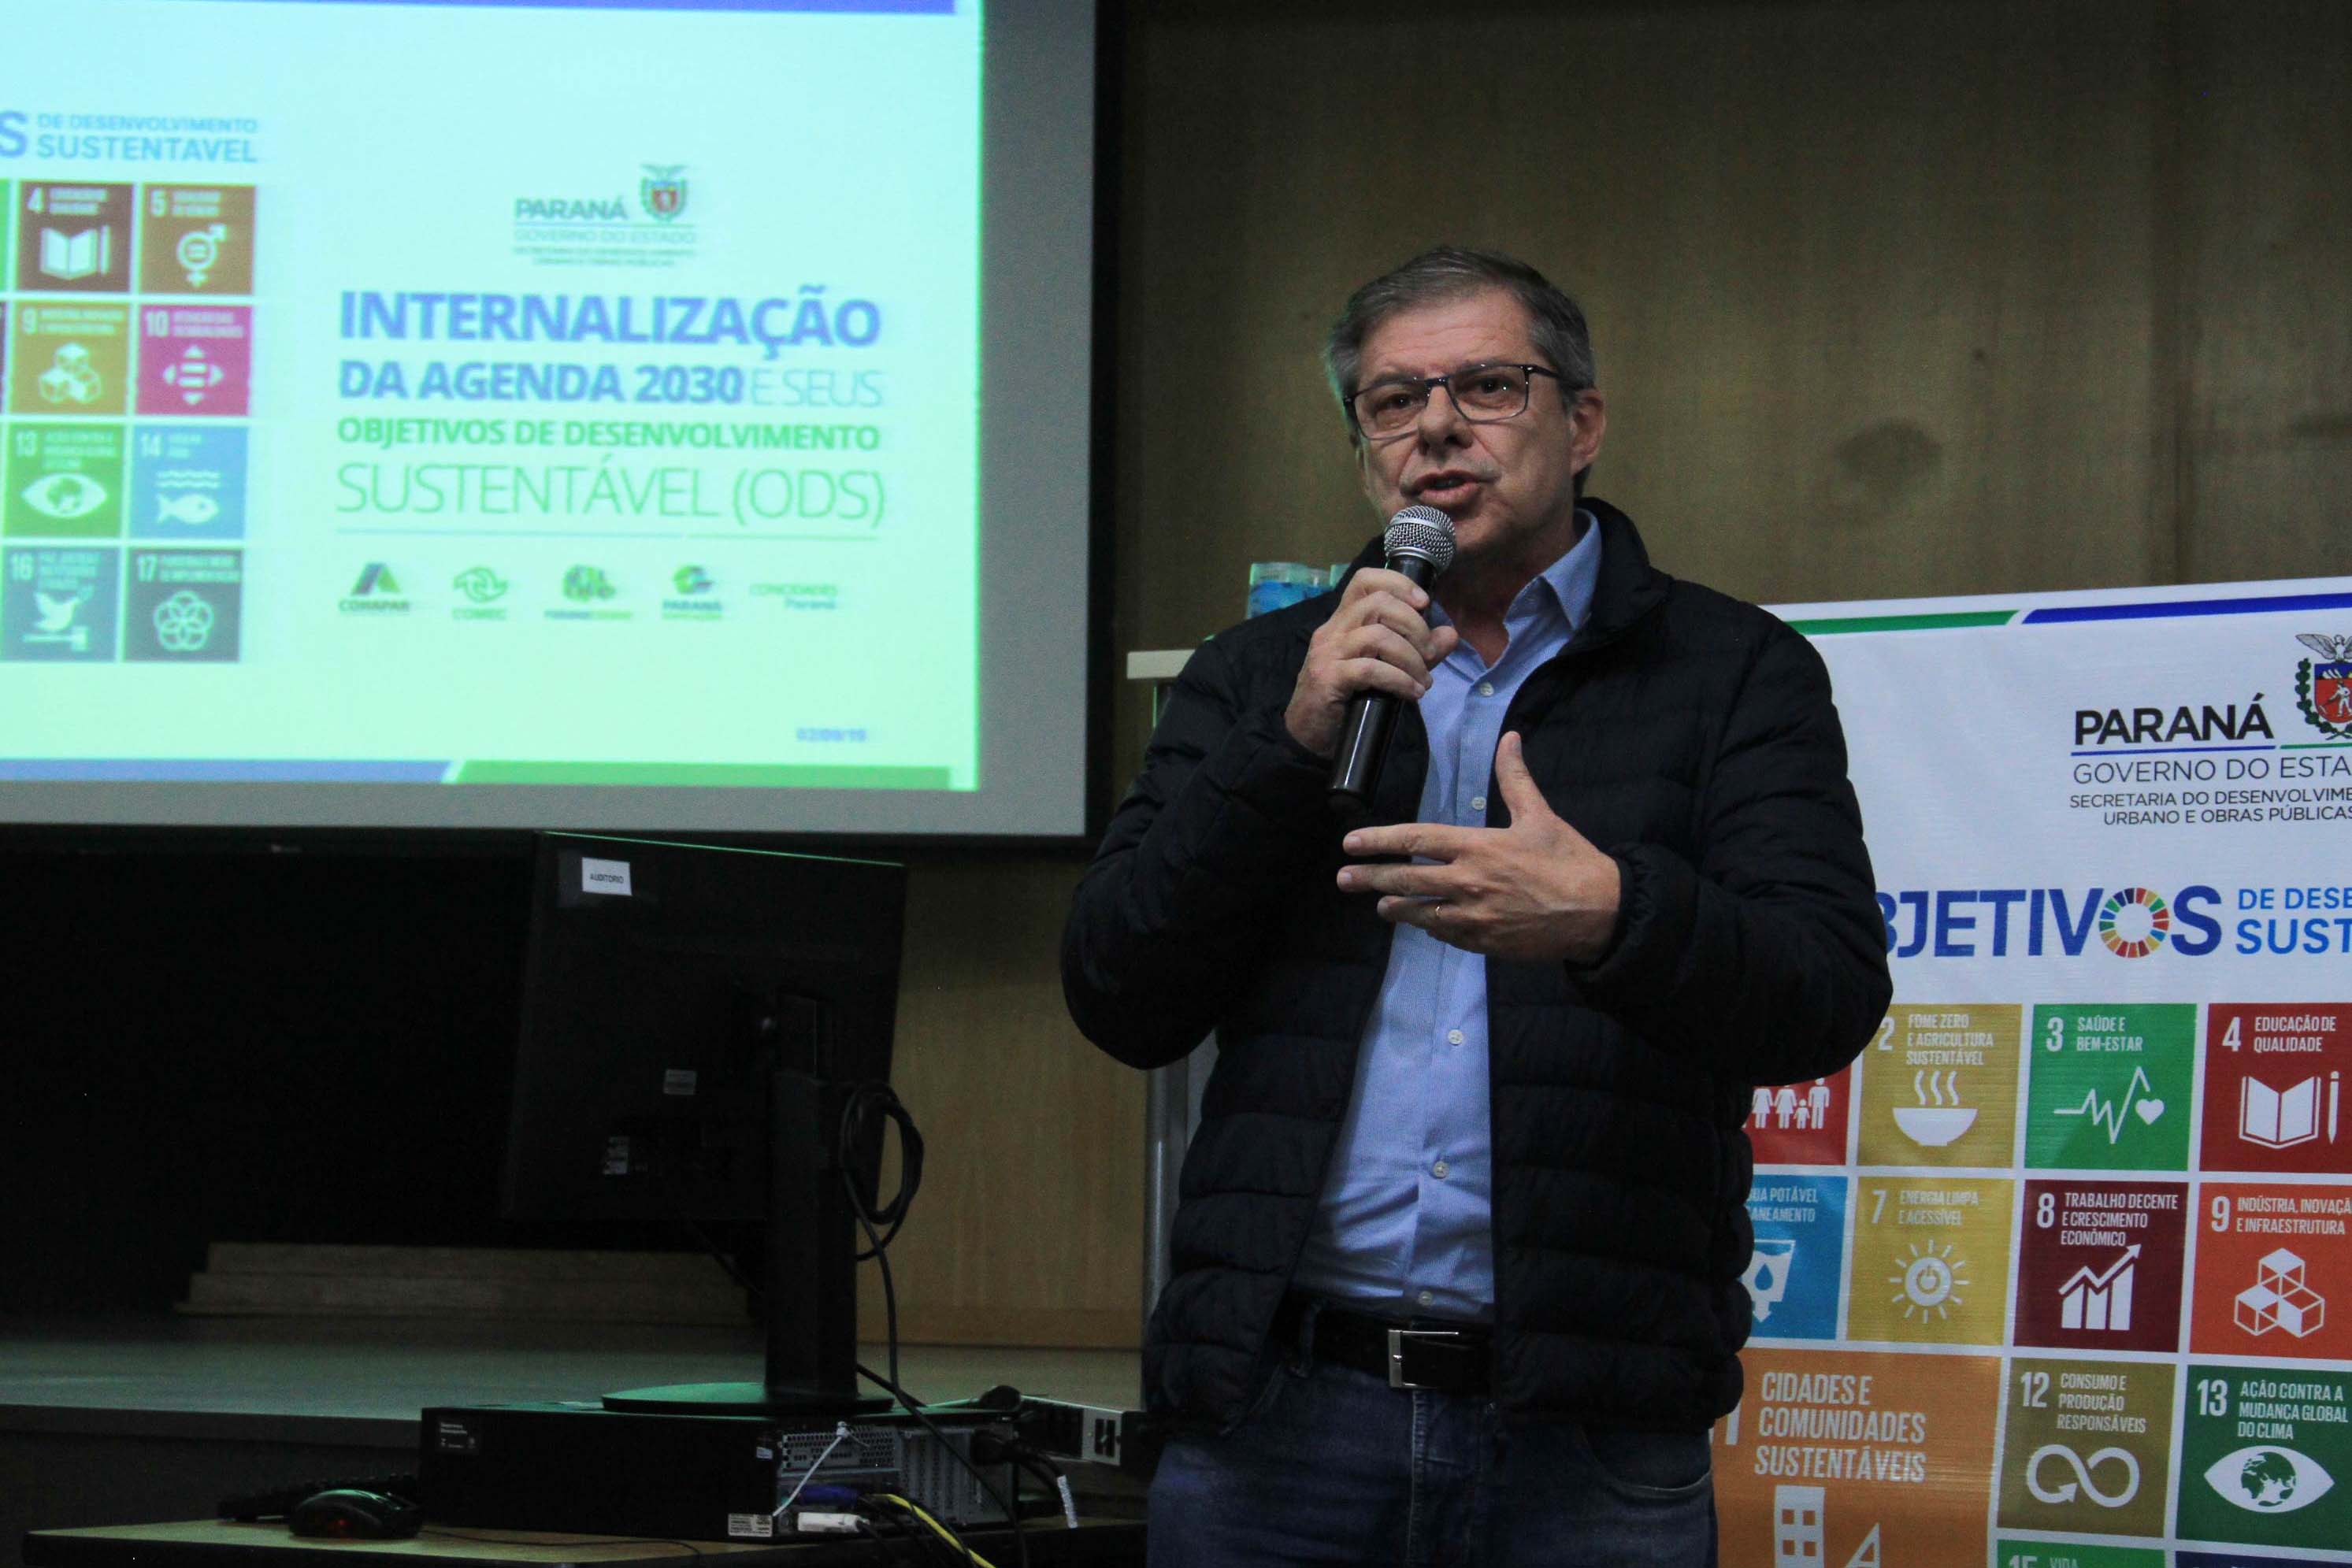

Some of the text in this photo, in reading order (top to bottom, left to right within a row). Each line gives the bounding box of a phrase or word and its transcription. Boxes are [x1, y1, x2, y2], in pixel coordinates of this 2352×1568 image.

[27, 187, 45, 213] 4
[514, 195, 629, 220] PARANÁ
[339, 284, 882, 360] INTERNALIZAÇÃO
[339, 361, 885, 408] DA AGENDA 2030 E SEUS
[337, 417, 881, 450] OBJETIVOS DE DESENVOLVIMENTO
[336, 454, 886, 527] SUSTENTÁVEL (ODS)
[2074, 692, 2274, 746] PARANÁ
[2072, 759, 2217, 784] GOVERNO
[2226, 757, 2270, 780] DO
[2069, 791, 2177, 810] SECRETARIA
[2183, 791, 2209, 806] DO
[2104, 810, 2179, 826] URBANO
[2186, 810, 2197, 825] E
[2201, 808, 2264, 825] OBRAS
[2238, 888, 2275, 910] DE
[1875, 885, 2222, 958] BJETIVOS
[2235, 917, 2352, 955] SUST
[1909, 1013, 1970, 1029] FOME ZERO
[2077, 1014, 2126, 1031] SAÚDE E
[2255, 1014, 2336, 1033] EDUCAÇÃO DE
[1877, 1017, 1895, 1051] 2
[1907, 1032, 1994, 1047] E AGRICULTURA
[2046, 1016, 2064, 1052] 3
[2076, 1036, 2143, 1052] BEM-ESTAR
[2222, 1016, 2242, 1052] 4
[2254, 1036, 2323, 1054] QUALIDADE
[1906, 1047, 1985, 1066] SUSTENTÁVEL
[1770, 1184, 1819, 1203] POTÁVEL
[1899, 1190, 1979, 1206] ENERGIA LIMPA
[2064, 1193, 2179, 1210] TRABALHO DECENTE
[1872, 1189, 1887, 1225] 7
[1898, 1207, 1964, 1225] E ACESSÍVEL
[2037, 1192, 2055, 1229] 8
[2211, 1195, 2231, 1233] 9
[2062, 1212, 2149, 1229] E CRESCIMENTO
[2237, 1217, 2346, 1235] E INFRAESTRUTURA
[2061, 1229, 2126, 1247] ECONÔMICO
[1761, 1372, 1873, 1406] CIDADES E
[2020, 1371, 2050, 1409] 12
[2060, 1373, 2127, 1390] CONSUMO E
[2239, 1380, 2344, 1402] AÇÃO CONTRA A
[2058, 1392, 2125, 1412] PRODUÇÃO
[2196, 1378, 2228, 1417] 13
[2057, 1412, 2147, 1434] RESPONSÁVEIS
[2239, 1403, 2350, 1424] MUDANÇA GLOBAL
[1758, 1407, 1927, 1445] COMUNIDADES
[2237, 1422, 2294, 1440] DO CLIMA
[1754, 1445, 1927, 1483] SUSTENTÁVEIS
